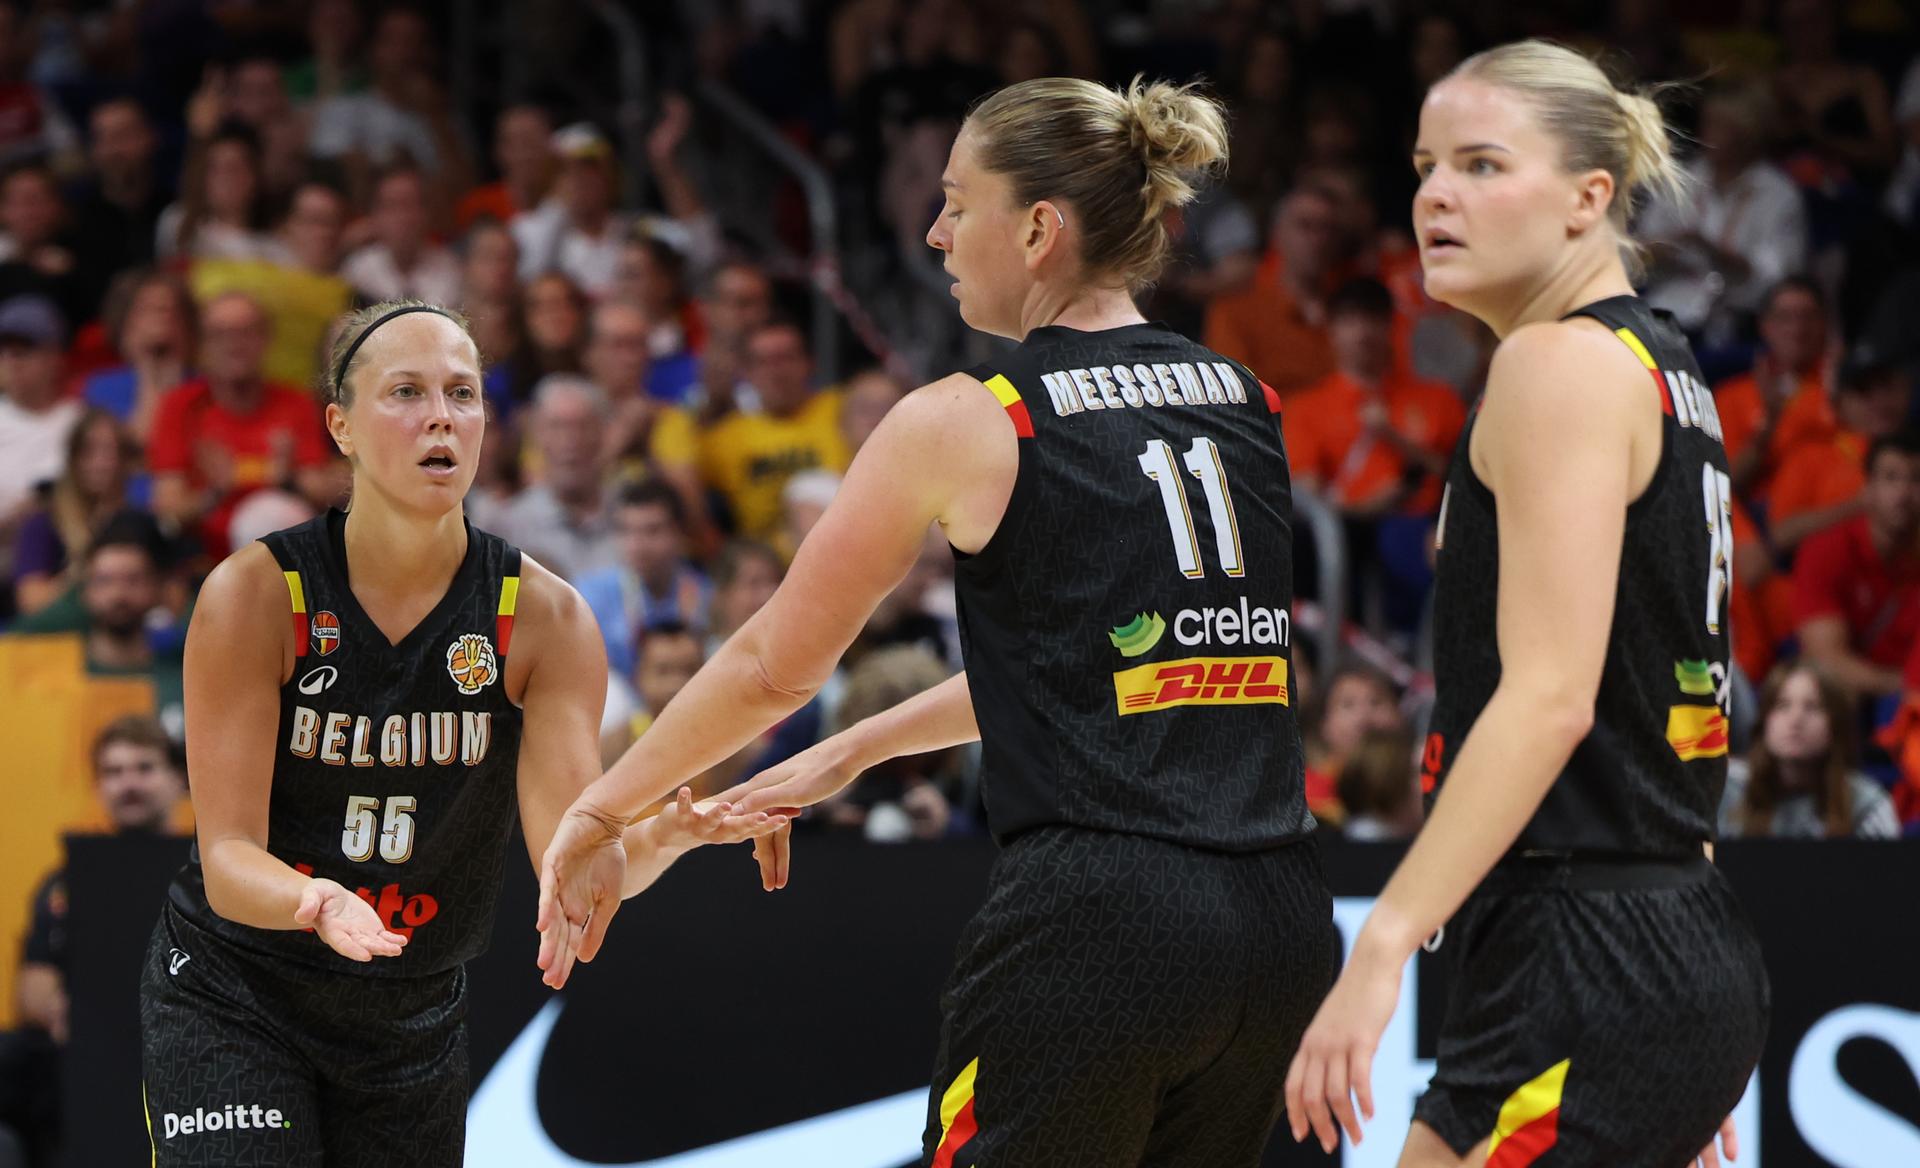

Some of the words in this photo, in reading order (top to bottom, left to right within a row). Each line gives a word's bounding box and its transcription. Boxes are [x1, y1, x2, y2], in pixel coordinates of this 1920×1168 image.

[1040, 362, 1248, 417] MEESSEMAN
[1137, 437, 1246, 580] 11
[1174, 596, 1289, 647] crelan
[1154, 662, 1280, 704] DHL
[290, 705, 492, 767] BELGIUM
[341, 795, 417, 864] 55
[164, 1104, 291, 1139] Deloitte.
